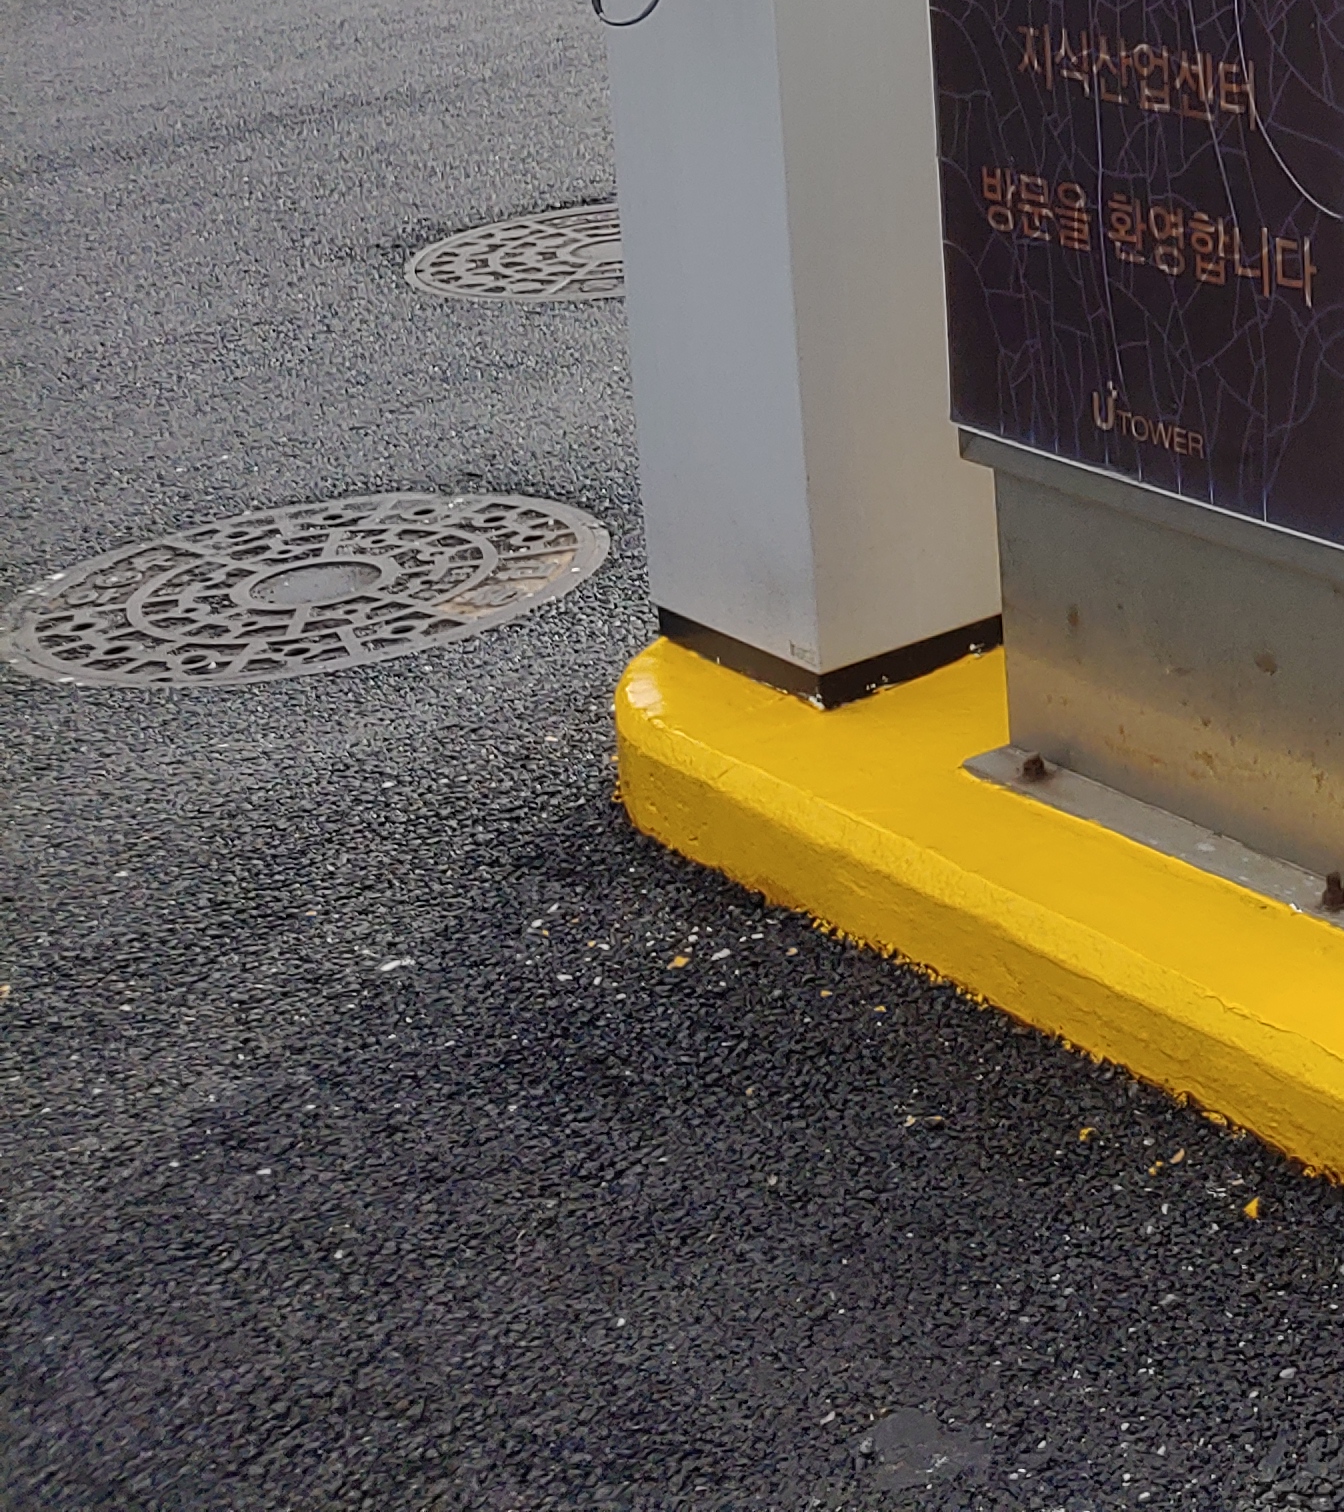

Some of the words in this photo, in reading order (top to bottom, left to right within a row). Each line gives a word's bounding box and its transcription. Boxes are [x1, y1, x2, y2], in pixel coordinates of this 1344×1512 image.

[1016, 24, 1256, 131] 지식산업센터
[982, 165, 1091, 252] 방문을
[1107, 192, 1318, 308] 환영합니다
